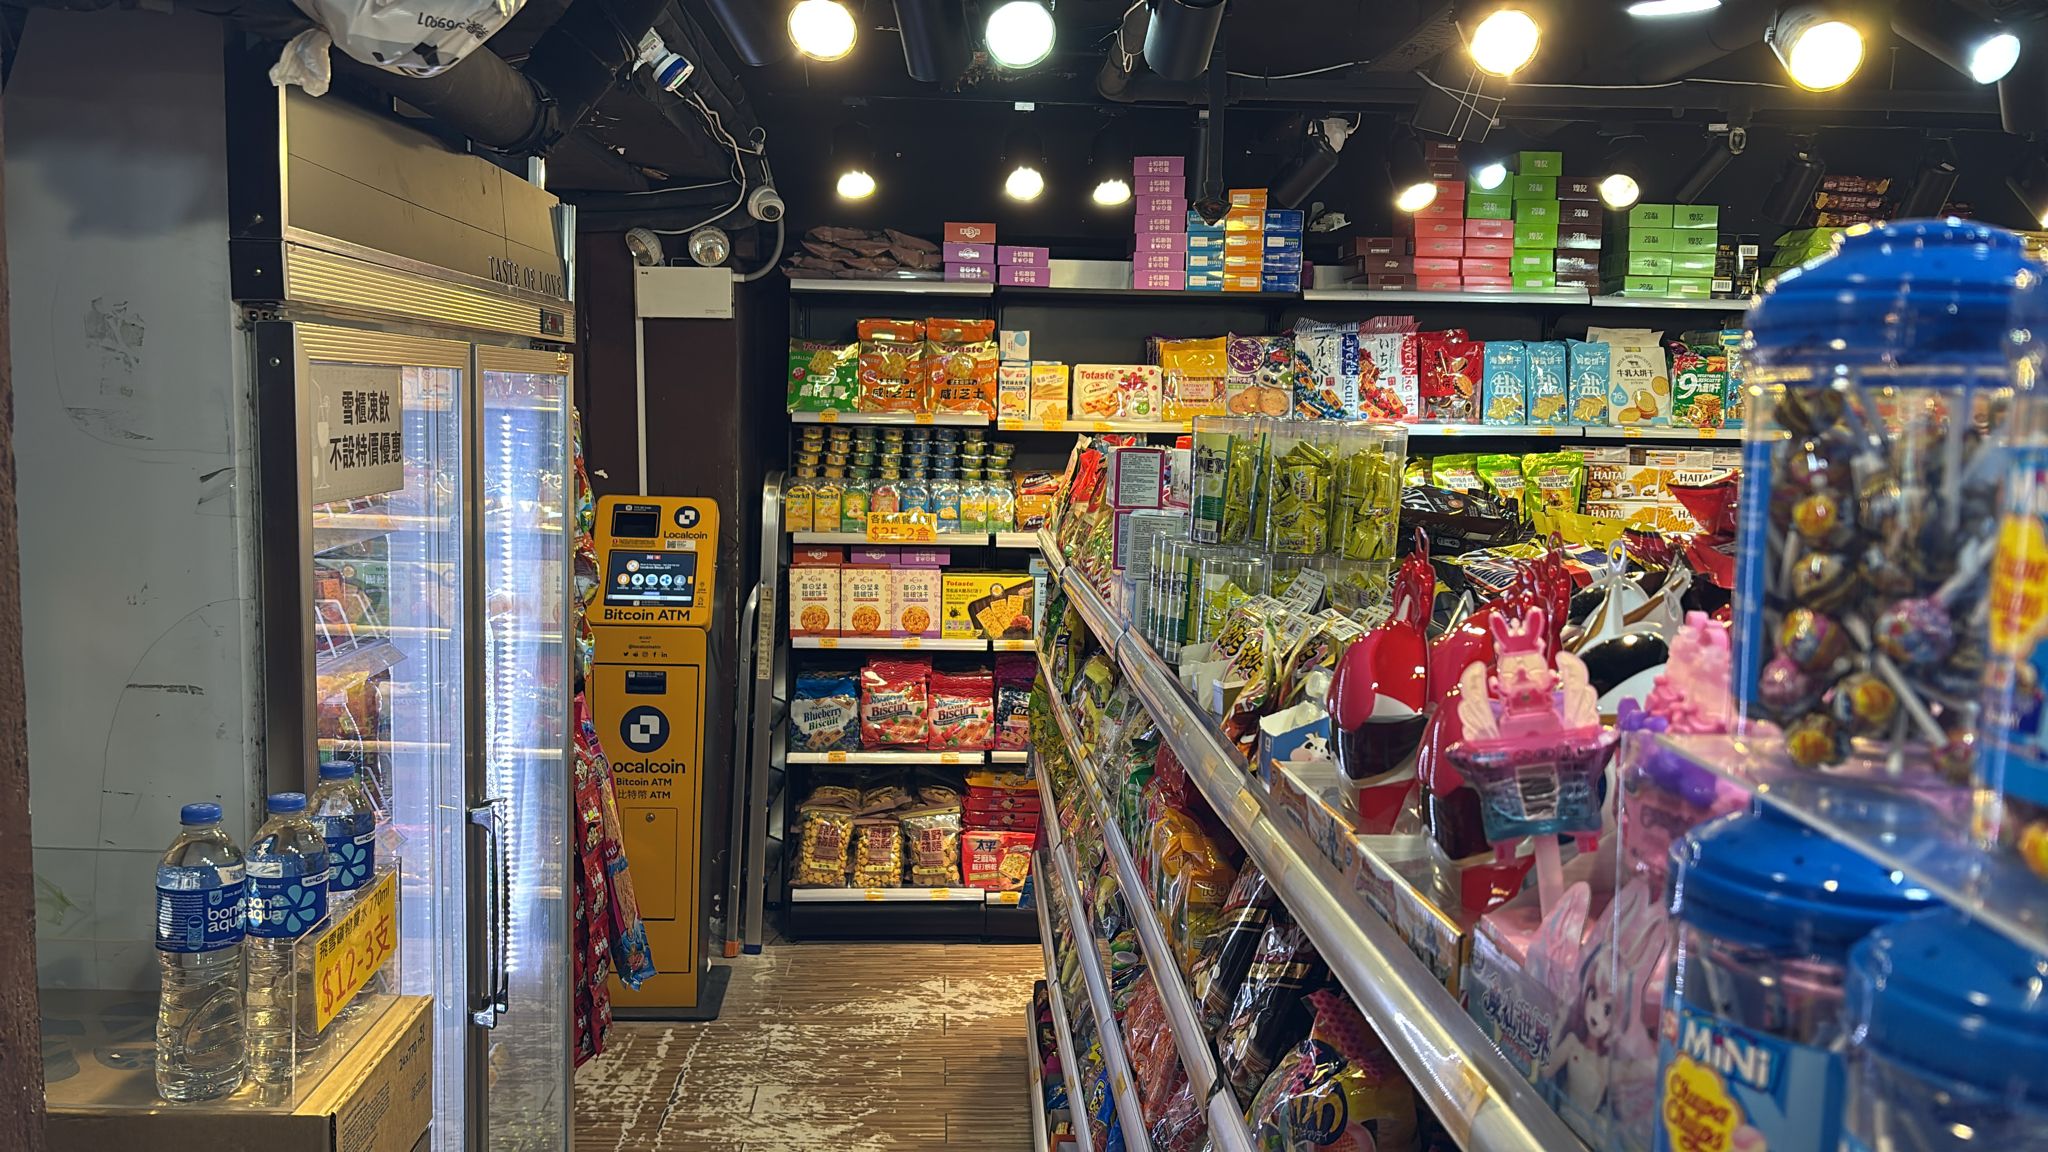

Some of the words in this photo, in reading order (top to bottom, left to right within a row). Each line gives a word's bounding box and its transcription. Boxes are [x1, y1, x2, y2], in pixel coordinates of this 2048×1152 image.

[488, 256, 520, 287] TASTE
[524, 267, 536, 291] OF
[539, 271, 563, 297] LOVE
[1379, 338, 1390, 381] いちご
[1080, 371, 1114, 379] Totaste
[1617, 369, 1654, 377] 牛乳大饼干
[1678, 373, 1698, 398] 9
[342, 390, 390, 425] 雪櫃凍飲
[330, 430, 401, 471] 不設特價優惠
[1594, 471, 1626, 480] HAITAI
[1680, 474, 1712, 482] HAITAI
[1591, 509, 1624, 518] HAITAI
[664, 531, 708, 540] Localcoin
[604, 609, 654, 621] Bitcoin
[658, 610, 690, 621] ATM
[804, 708, 842, 722] Blueberry
[872, 703, 908, 716] BISCUIT
[938, 706, 975, 720] BISCUIT
[808, 717, 839, 730] Biscuit
[613, 759, 685, 774] ocalcoin
[616, 778, 649, 786] Bitcoin
[651, 778, 672, 786] ATM
[617, 789, 647, 799] 比特幣
[650, 791, 670, 799] ATM
[974, 839, 997, 852] 太平
[973, 855, 997, 863] 芝麻味
[369, 880, 391, 914] 770ml
[208, 906, 237, 921] bon
[208, 918, 238, 932] aqu
[322, 912, 391, 1016] $12-3支
[1683, 1018, 1770, 1089] MiNi
